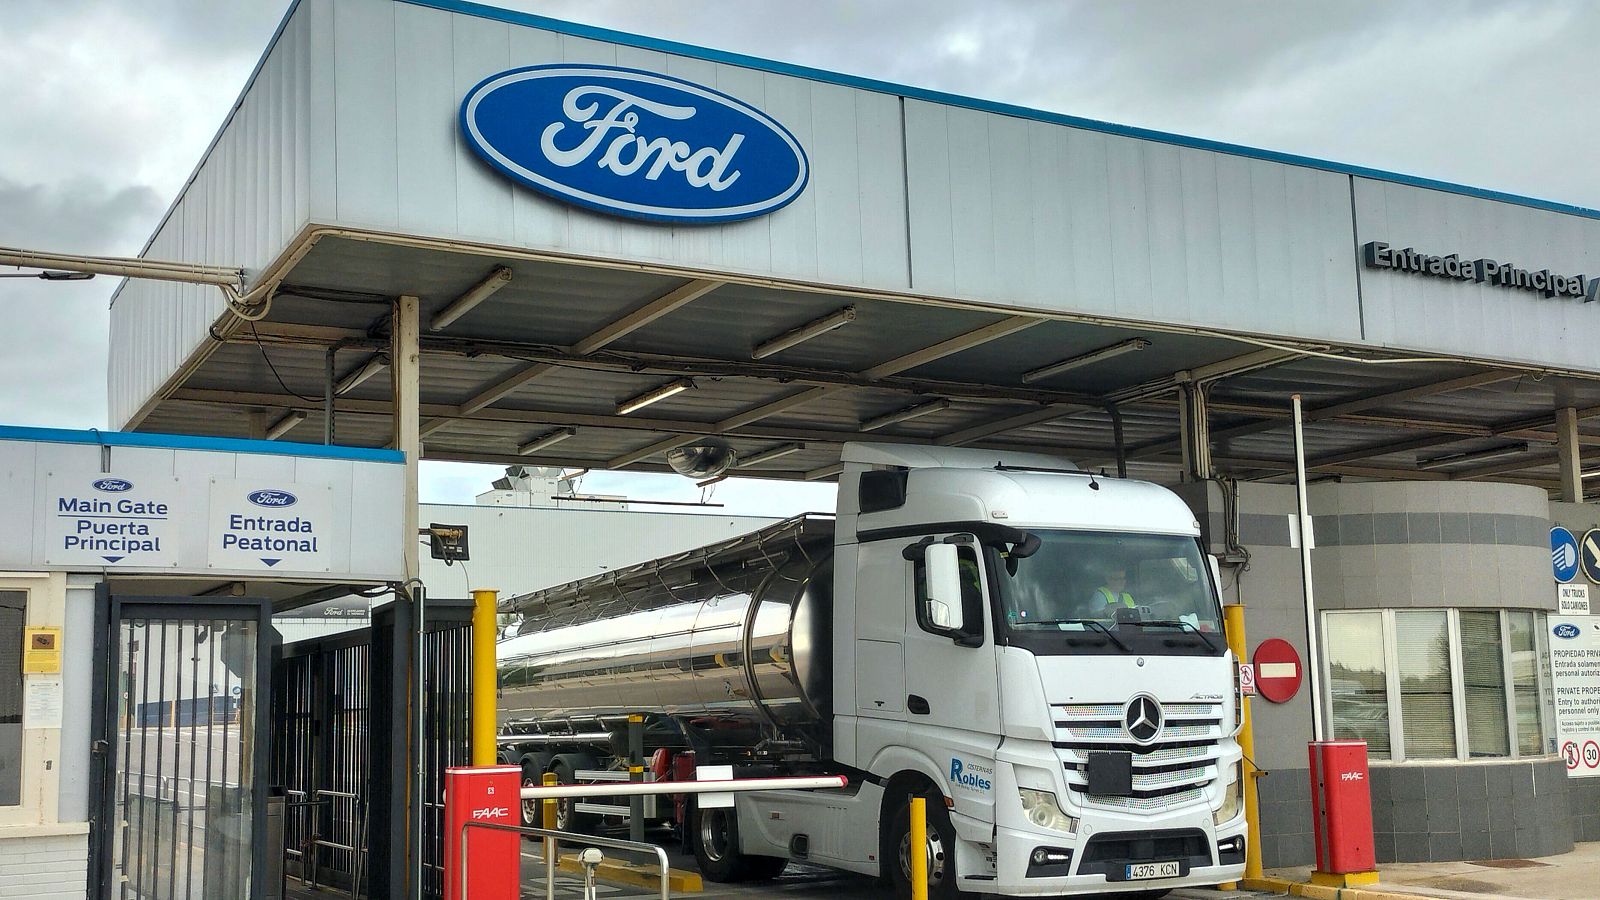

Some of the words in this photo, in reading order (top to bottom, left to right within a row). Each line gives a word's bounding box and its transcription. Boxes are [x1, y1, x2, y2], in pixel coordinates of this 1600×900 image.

[540, 85, 745, 191] Ford
[1365, 241, 1476, 281] Entrada
[1477, 258, 1588, 297] Principal
[256, 492, 288, 504] Ford
[58, 498, 112, 513] Main
[117, 500, 168, 516] Gate
[77, 520, 150, 536] Puerta
[229, 515, 312, 533] Entrada
[64, 534, 161, 553] Principal
[223, 534, 318, 553] Peatonal
[1563, 588, 1571, 598] ONLY
[1571, 589, 1585, 598] TRUCKS
[1561, 601, 1570, 610] SOLO
[1570, 601, 1588, 610] CAMIONES
[1558, 626, 1576, 637] Ford
[1554, 649, 1585, 658] PROPIEDAD
[1555, 660, 1576, 668] Entrada
[1556, 670, 1580, 678] personal
[1557, 687, 1580, 695] PRIVATE
[1558, 698, 1572, 707] Entry
[1587, 707, 1600, 715] only
[1586, 749, 1597, 760] 30
[951, 758, 991, 790] Robles
[967, 763, 993, 774] CISTERNAS
[1341, 771, 1364, 781] FAAC
[473, 807, 508, 819] FAAC
[1133, 865, 1155, 877] 4376
[1160, 863, 1177, 876] KCN
